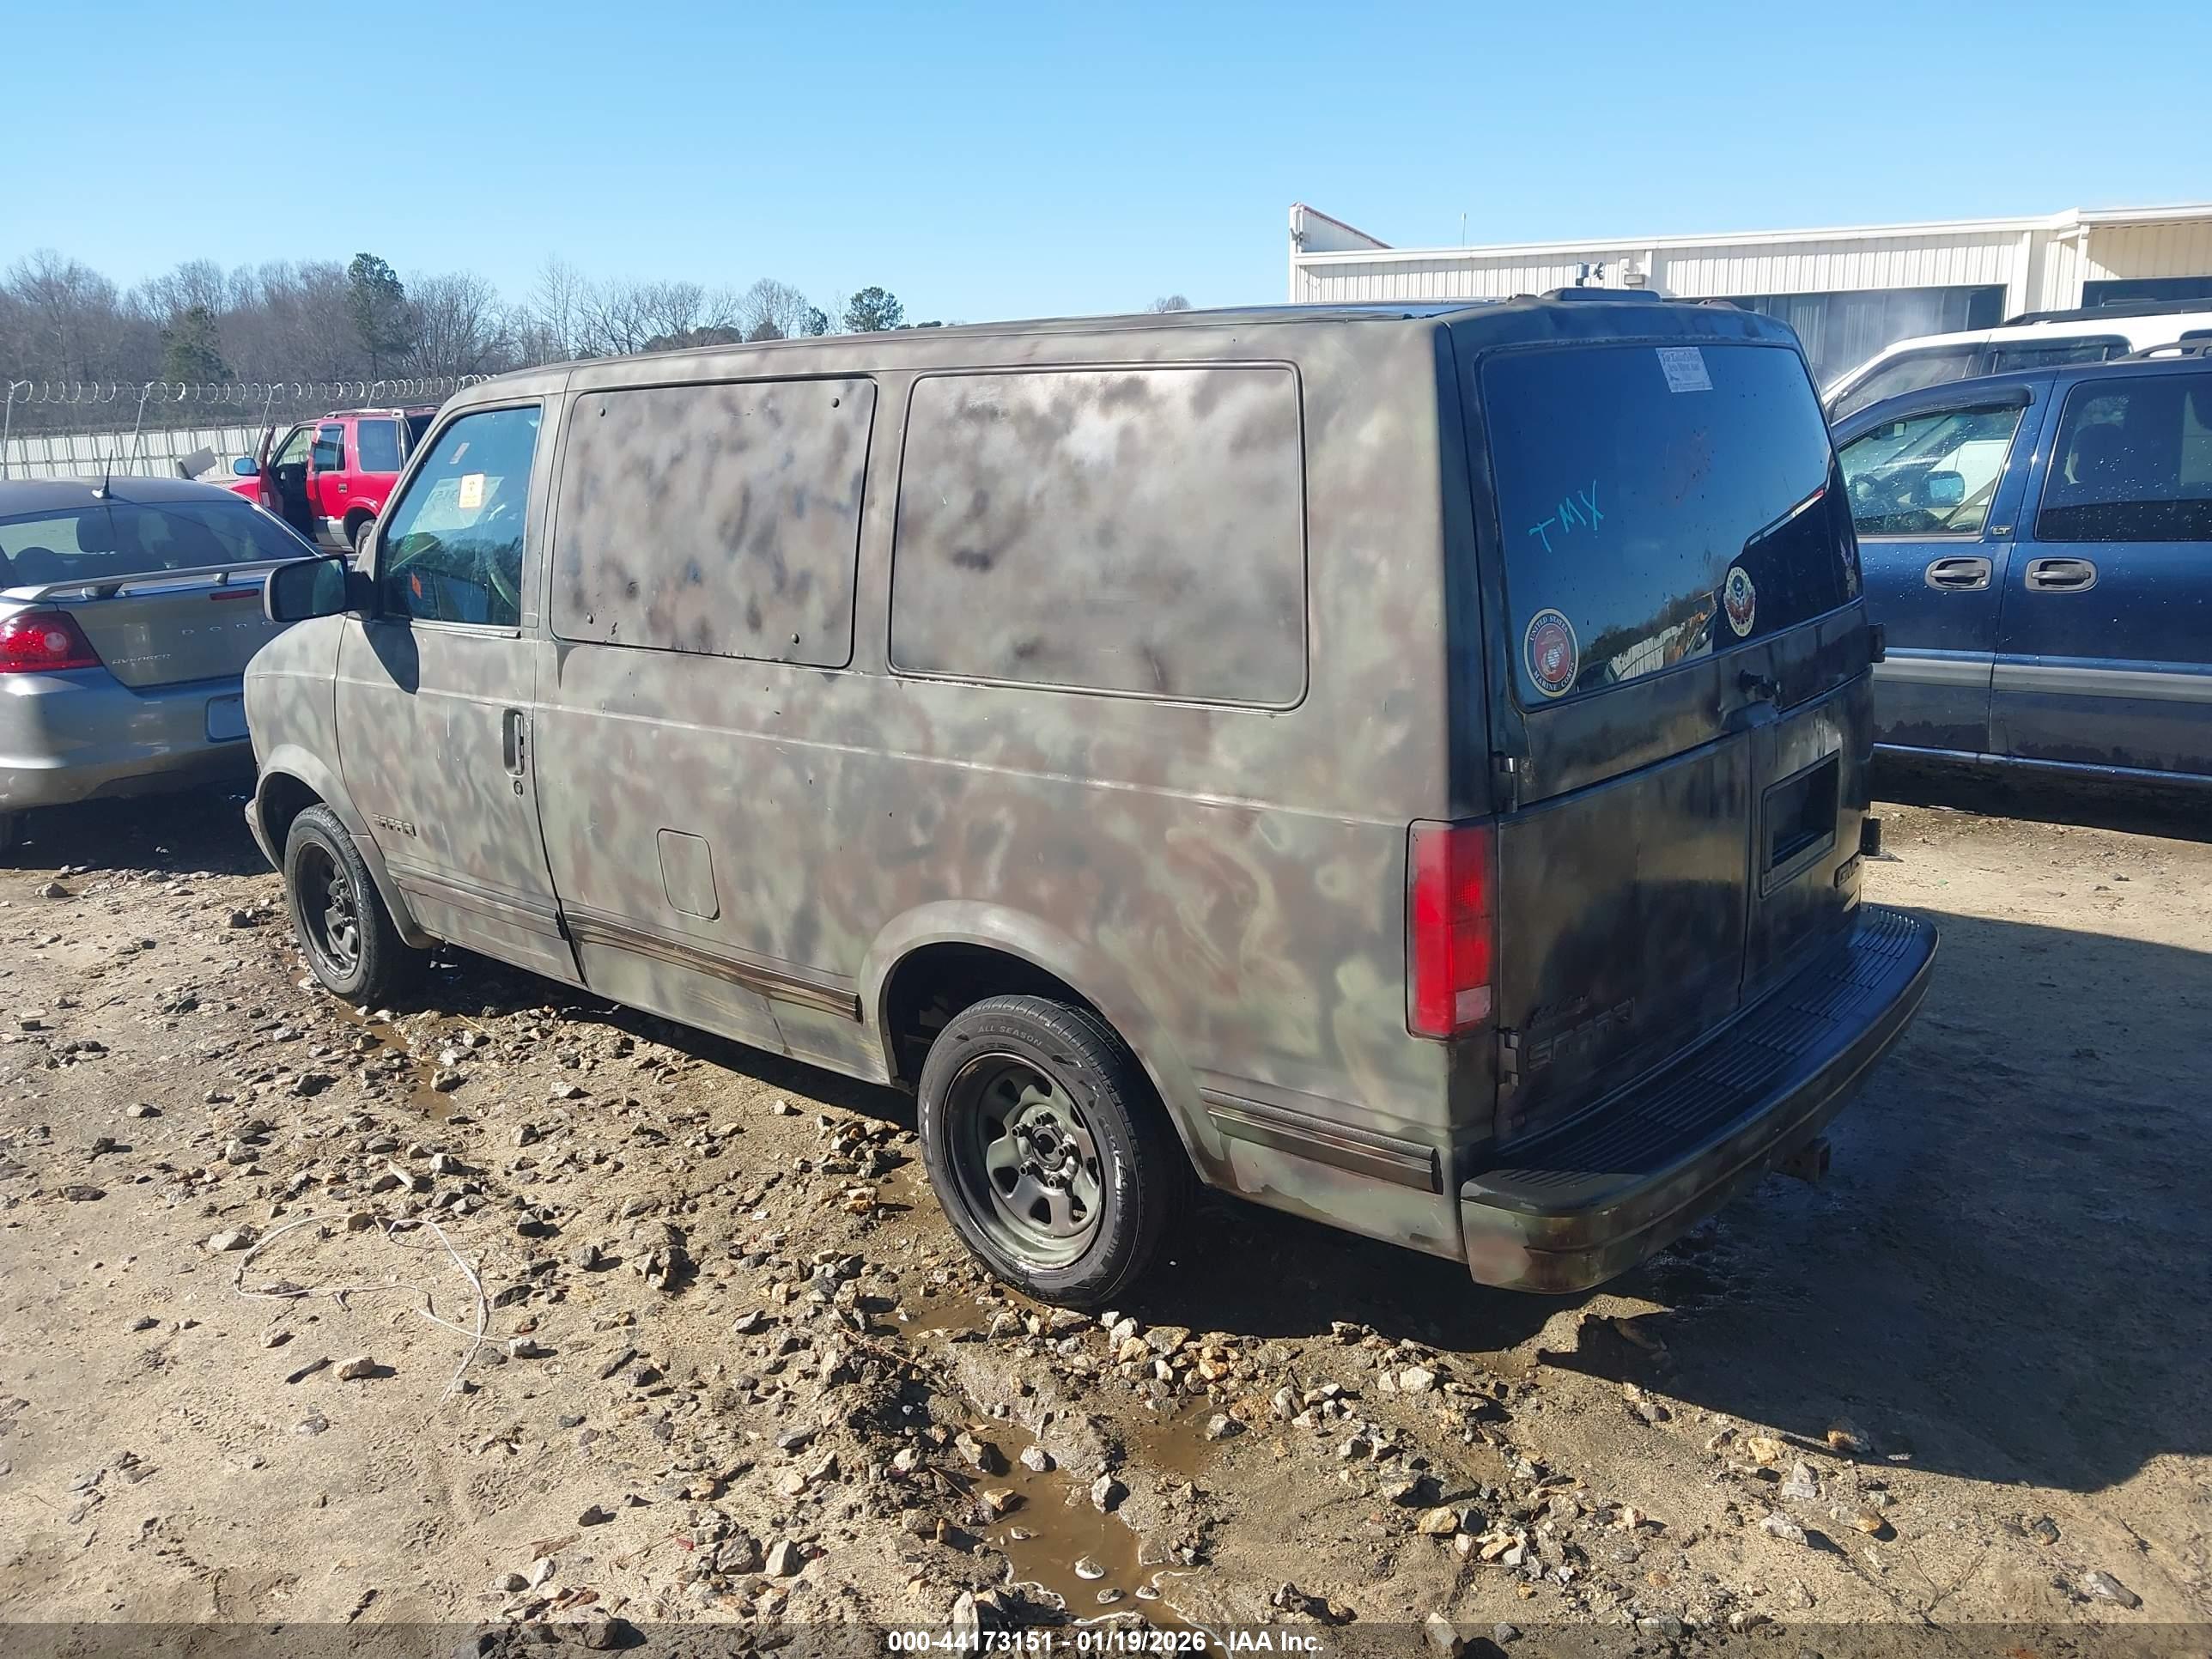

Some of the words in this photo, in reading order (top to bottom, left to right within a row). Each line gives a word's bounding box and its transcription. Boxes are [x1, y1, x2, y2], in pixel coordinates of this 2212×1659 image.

[1528, 479, 1604, 553] TMX
[181, 620, 274, 635] DODG
[1529, 616, 1547, 641] UNITED
[1549, 615, 1568, 633] STATES
[111, 653, 172, 665] AVENGER
[1533, 670, 1558, 691] MARINE
[1560, 661, 1575, 688] CORPS
[977, 1024, 995, 1033] ALL
[998, 1025, 1043, 1047] SEASON
